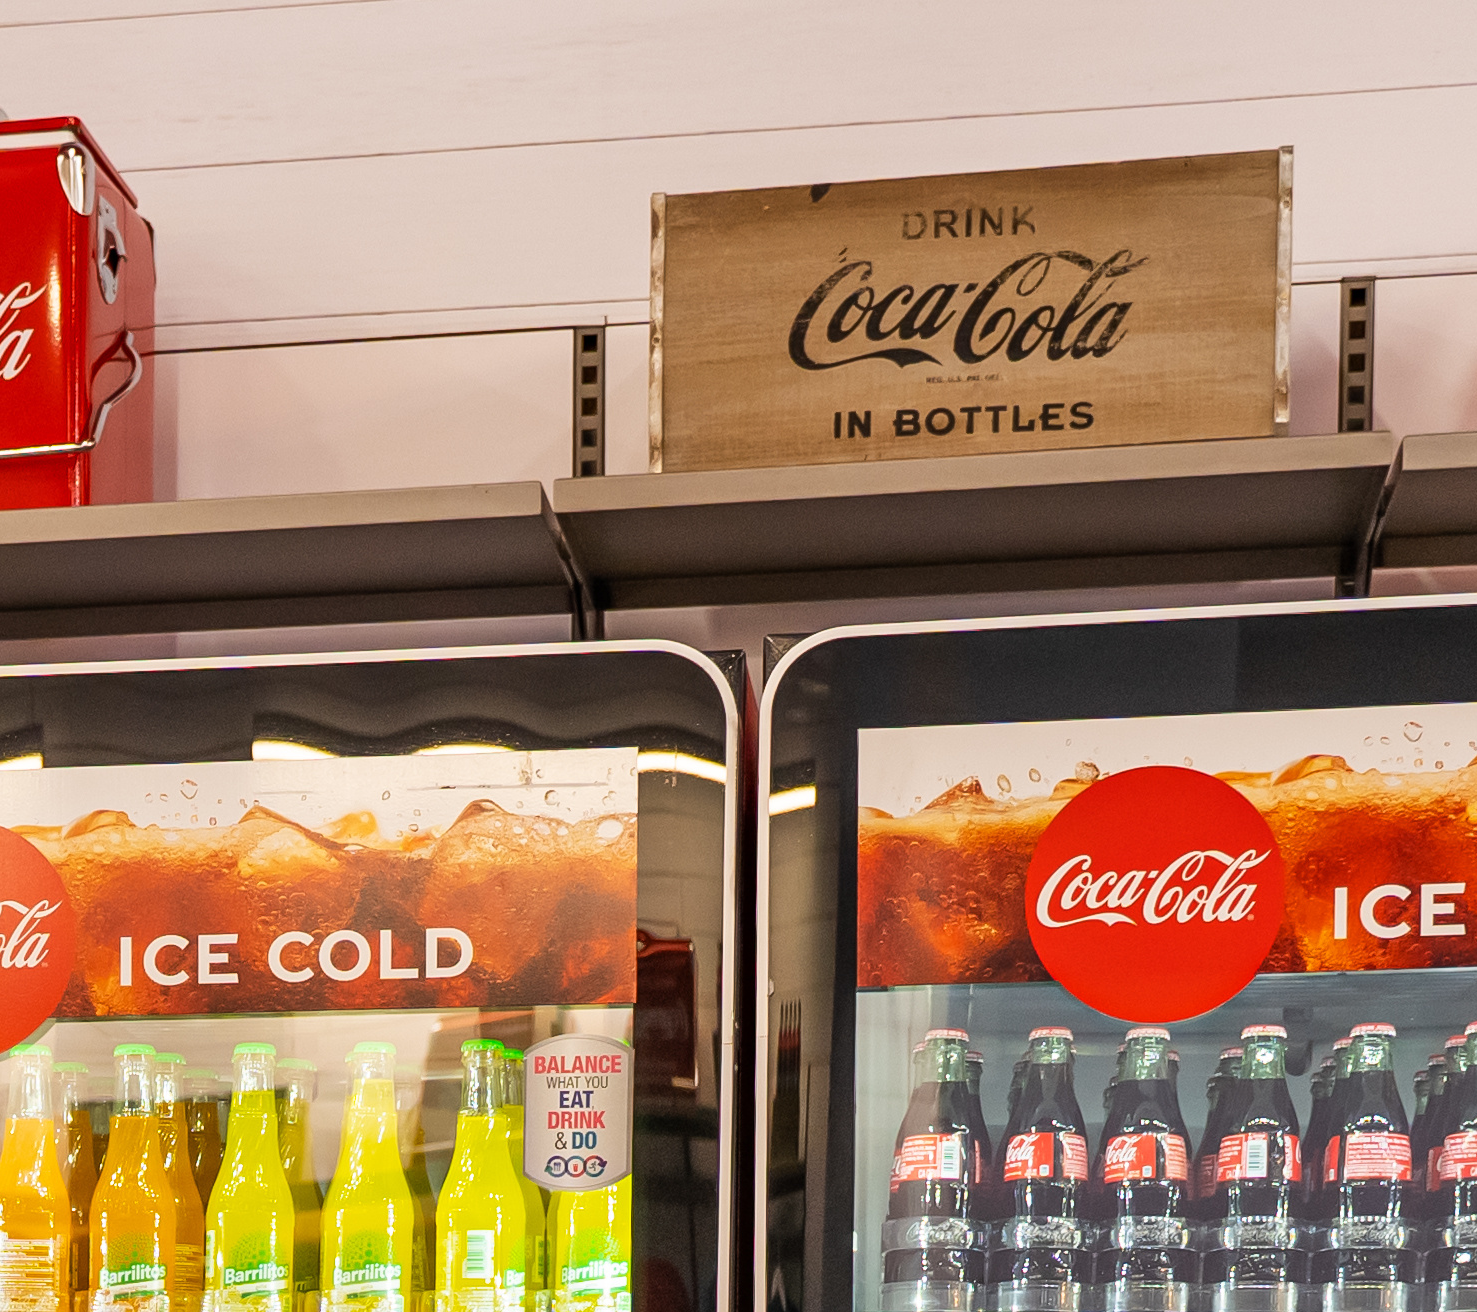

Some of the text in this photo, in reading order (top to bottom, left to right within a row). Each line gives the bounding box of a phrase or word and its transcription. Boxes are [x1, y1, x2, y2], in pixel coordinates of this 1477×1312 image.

[900, 204, 1037, 240] DRINK
[788, 248, 1151, 371] Coca-Cola
[833, 402, 1095, 440] IN BOTTLES
[1036, 849, 1271, 929] Coca-Cola
[1334, 882, 1465, 939] ICE
[120, 927, 473, 987] ICE COLD
[534, 1054, 623, 1075] BALANCE
[546, 1075, 609, 1090] WHAT YOU
[547, 1111, 606, 1130] DRINK
[554, 1131, 598, 1150] & DO
[98, 1263, 166, 1288] Barrilitos
[224, 1262, 290, 1285] Barrilitos
